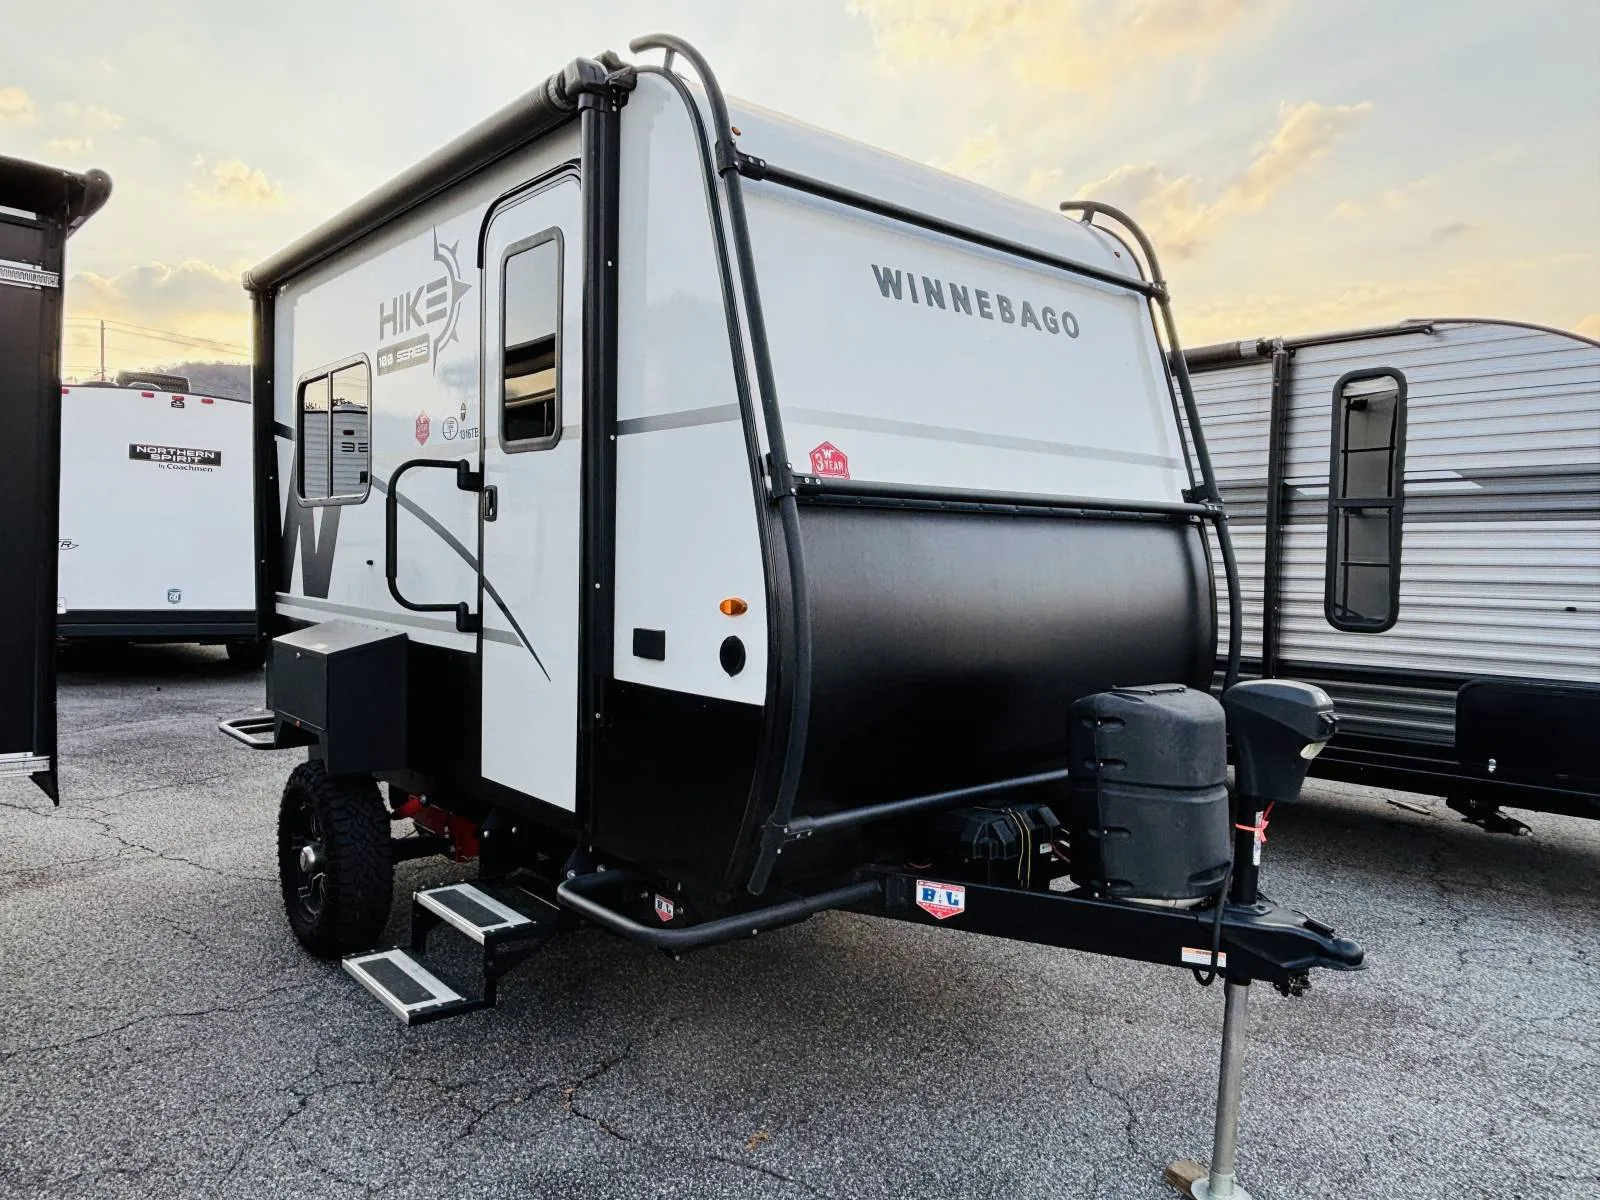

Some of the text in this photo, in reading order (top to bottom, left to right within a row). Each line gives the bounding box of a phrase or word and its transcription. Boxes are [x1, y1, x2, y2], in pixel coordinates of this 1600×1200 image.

[379, 276, 447, 340] HIKE
[871, 264, 1080, 339] WINNEBAGO
[396, 342, 429, 363] SERIES
[136, 445, 215, 459] NORTHERN
[150, 453, 202, 463] SPIRIT
[166, 463, 213, 472] Coachmen
[815, 453, 845, 473] 3 YEAR
